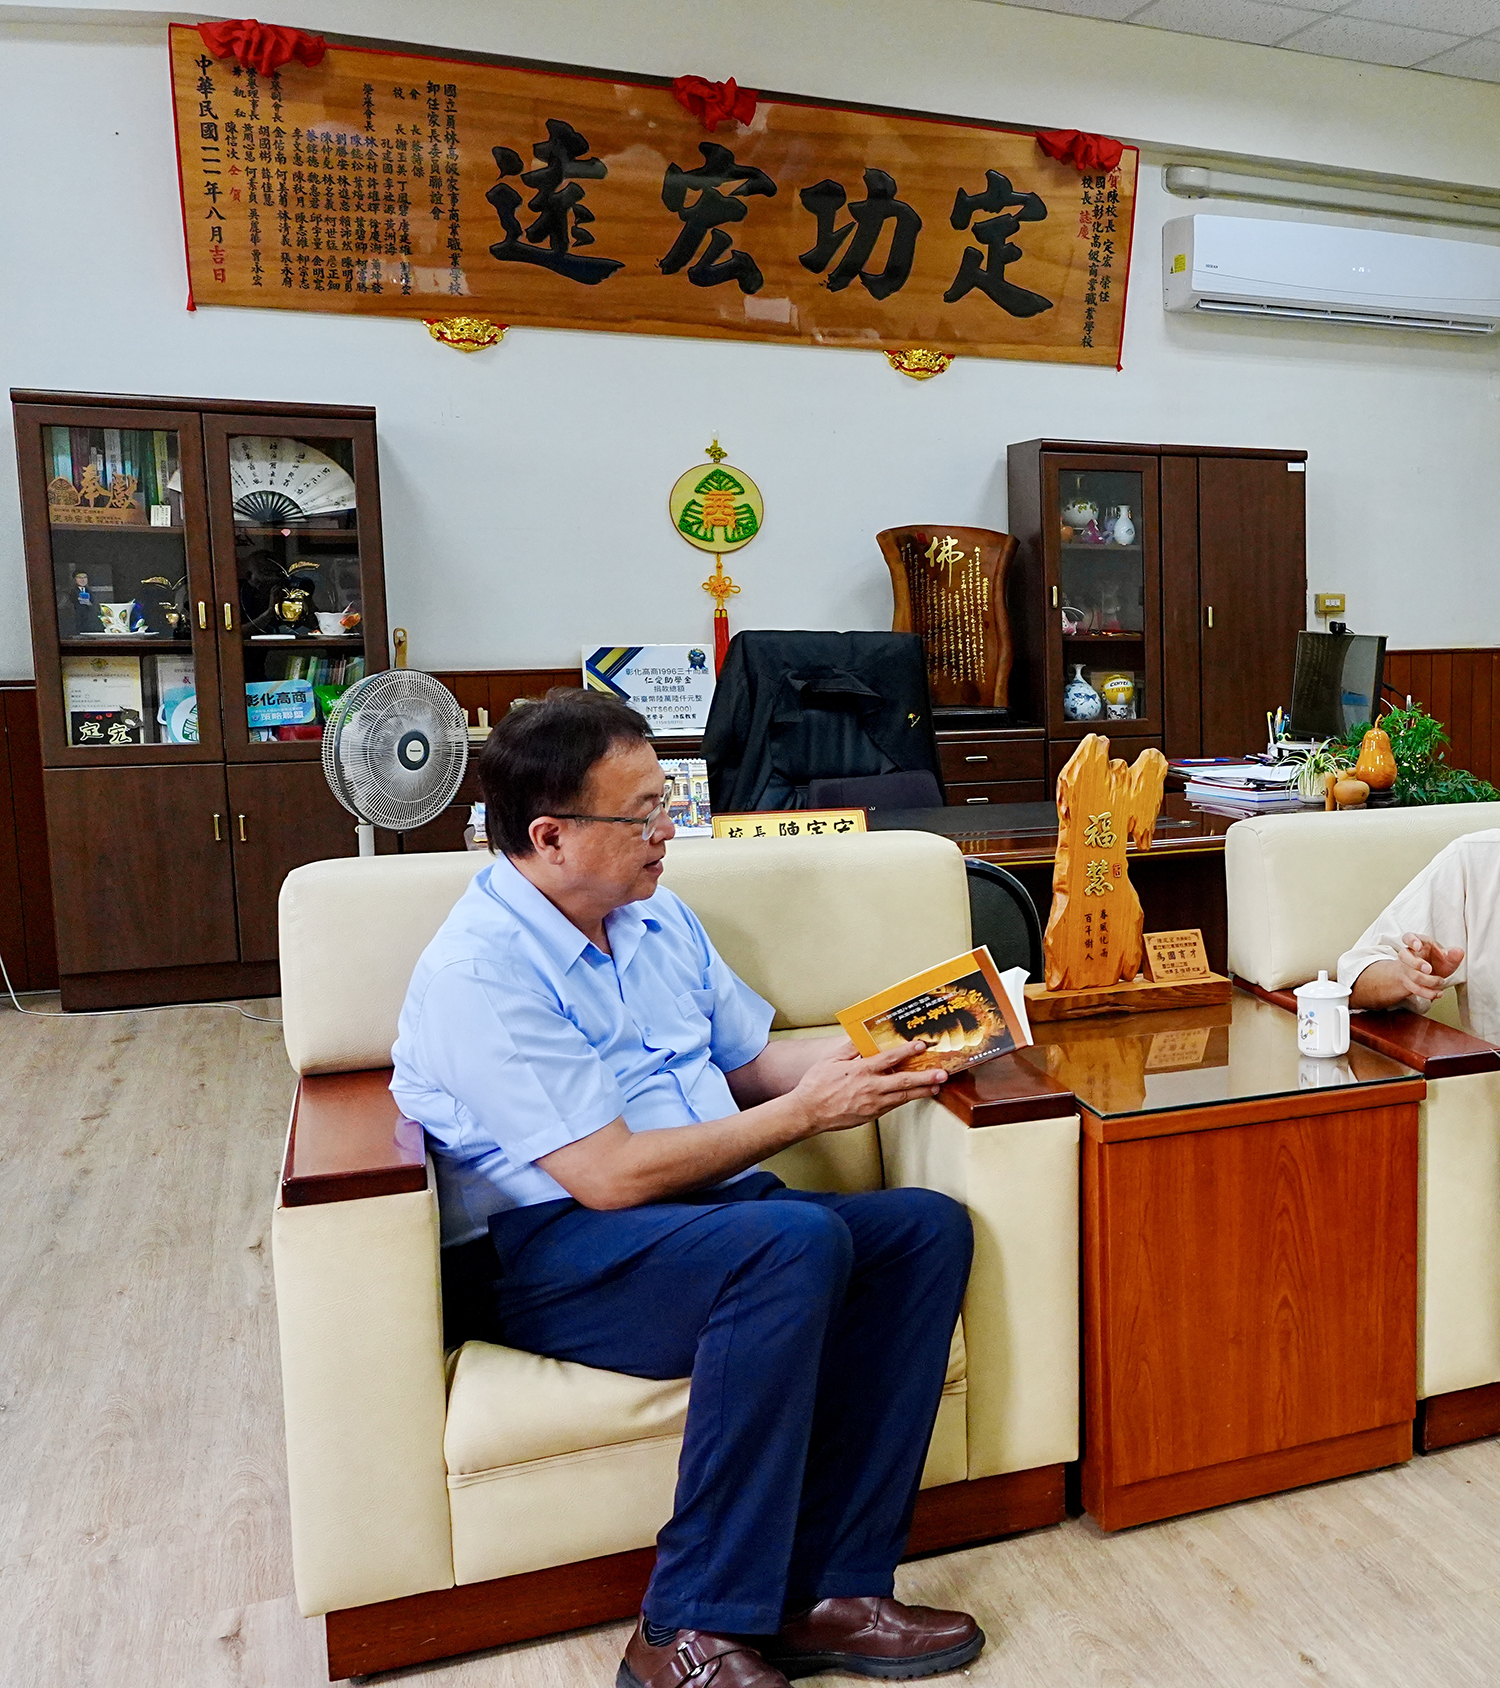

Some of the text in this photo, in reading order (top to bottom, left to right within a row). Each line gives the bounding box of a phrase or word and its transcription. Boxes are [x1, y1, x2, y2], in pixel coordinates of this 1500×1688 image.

[1081, 176, 1106, 348] 國立彰化高級商業職業學校
[925, 535, 965, 587] 佛
[1084, 812, 1117, 896] 福慧
